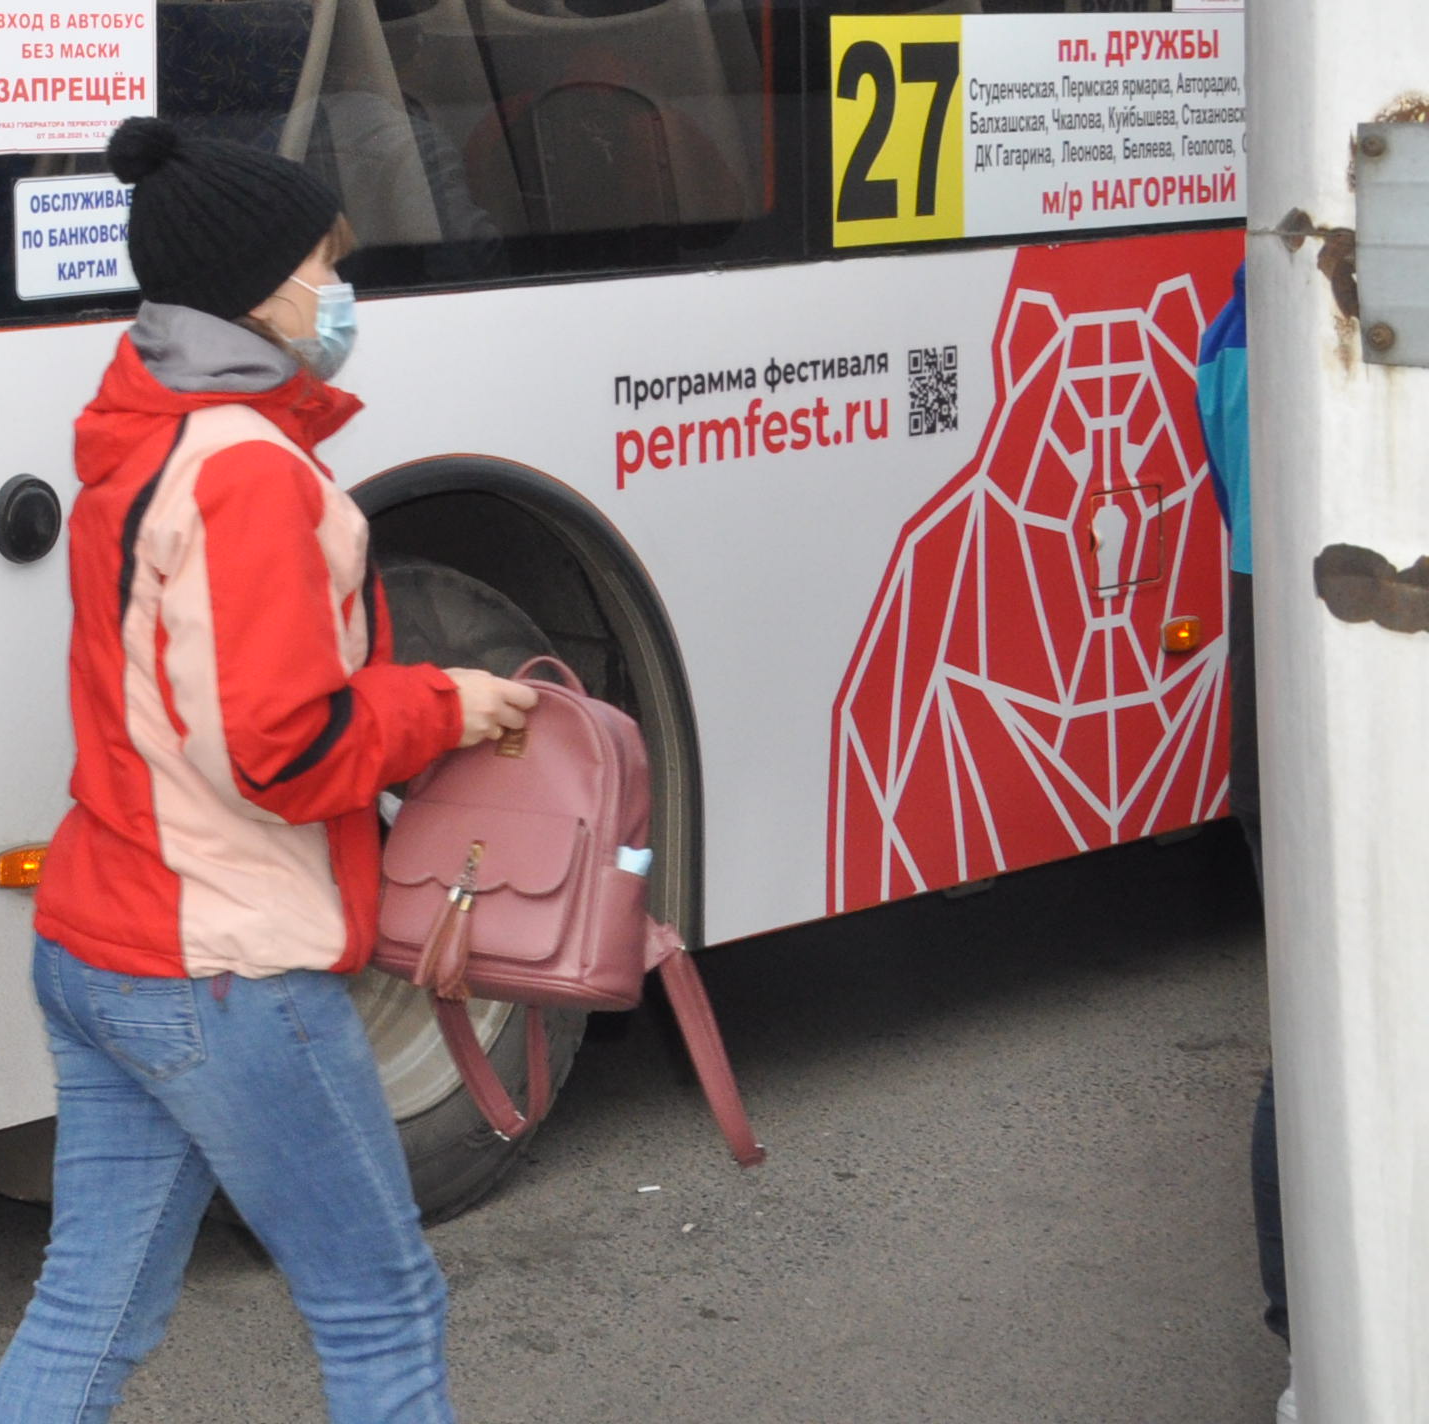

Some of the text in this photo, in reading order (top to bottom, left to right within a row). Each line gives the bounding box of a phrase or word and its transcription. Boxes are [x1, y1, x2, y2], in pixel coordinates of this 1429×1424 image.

[50, 14, 61, 29] В
[67, 13, 145, 29] АВТОБУС
[22, 43, 120, 59] БЕЗ МАСКИ
[1058, 29, 1219, 67] пл. ДРУЖБЫ
[969, 72, 1240, 106] Студенческая, Пермская ярмарка, Авторадио,
[836, 40, 959, 223] 27
[969, 103, 1246, 135] Балхашская, Чкалова, Куйбышева, Стахановск
[974, 144, 993, 172] ДК
[996, 143, 1055, 171] Гагарина,
[1061, 140, 1117, 164] Леонова,
[1123, 137, 1175, 160] Беляева,
[1182, 134, 1236, 158] Геологов,
[30, 188, 134, 214] ОБСЛУЖИВАЕ
[1042, 165, 1236, 221] м/р НАГОРНЫЙ
[22, 223, 131, 249] ПО БАНКОВСК
[58, 258, 117, 281] КАРТАМ
[615, 352, 889, 410] Программа фестиваля
[616, 396, 888, 490] permfest.ru
